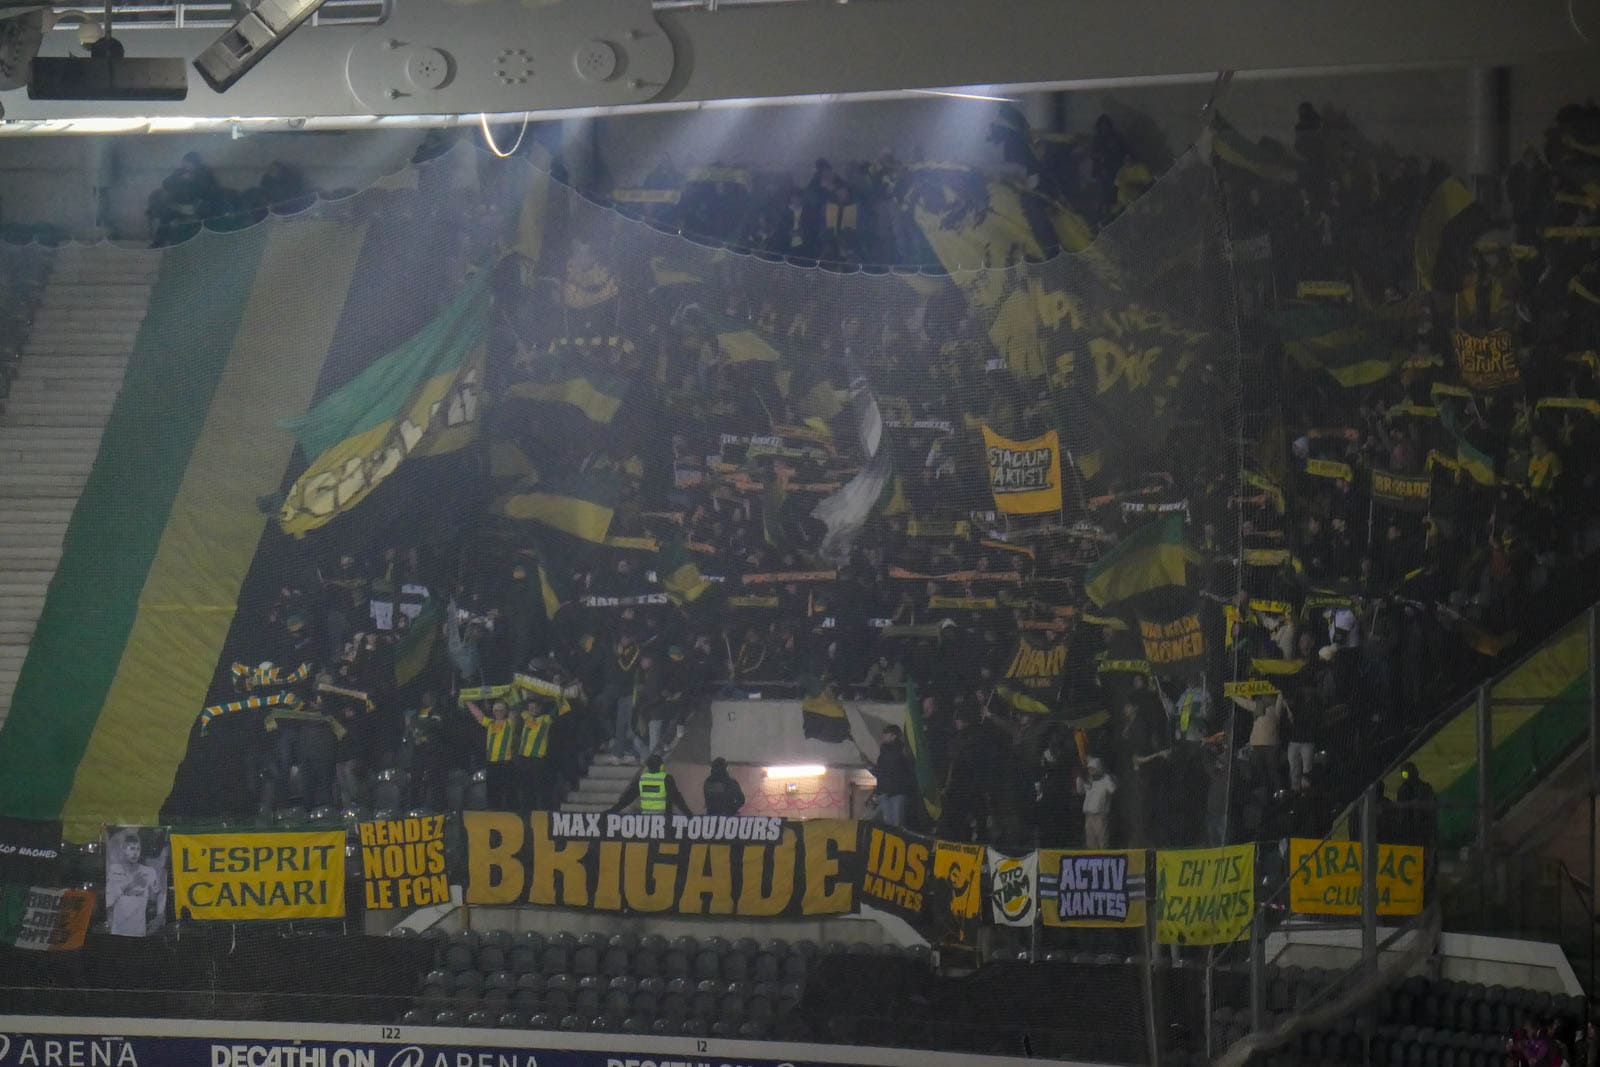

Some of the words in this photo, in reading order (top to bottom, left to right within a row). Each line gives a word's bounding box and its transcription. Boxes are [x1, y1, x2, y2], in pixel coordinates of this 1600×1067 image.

[992, 465, 1044, 486] ARTIST
[360, 814, 445, 846] RENDEZ
[552, 811, 601, 837] MAX
[607, 813, 665, 839] POUR
[671, 814, 783, 841] TOUJOURS
[182, 844, 335, 873] L'ESPRIT
[362, 839, 445, 879] NOUS
[463, 811, 858, 916] BRIGADE
[867, 827, 929, 890] IDS
[1060, 857, 1126, 891] ACTIV
[1178, 855, 1243, 890] CH'TIS
[1299, 844, 1416, 885] STRAAC
[187, 880, 327, 907] CANARI
[365, 880, 393, 909] LE
[398, 873, 450, 908] FCN
[862, 873, 924, 912] NANTES
[1060, 890, 1127, 918] NANTES
[1323, 885, 1364, 905] CLU
[1167, 888, 1251, 926] CANARIS
[382, 1026, 401, 1039] 122
[697, 1039, 707, 1052] 12
[19, 1039, 138, 1067] ARENA
[211, 1045, 375, 1067] DECATHLON
